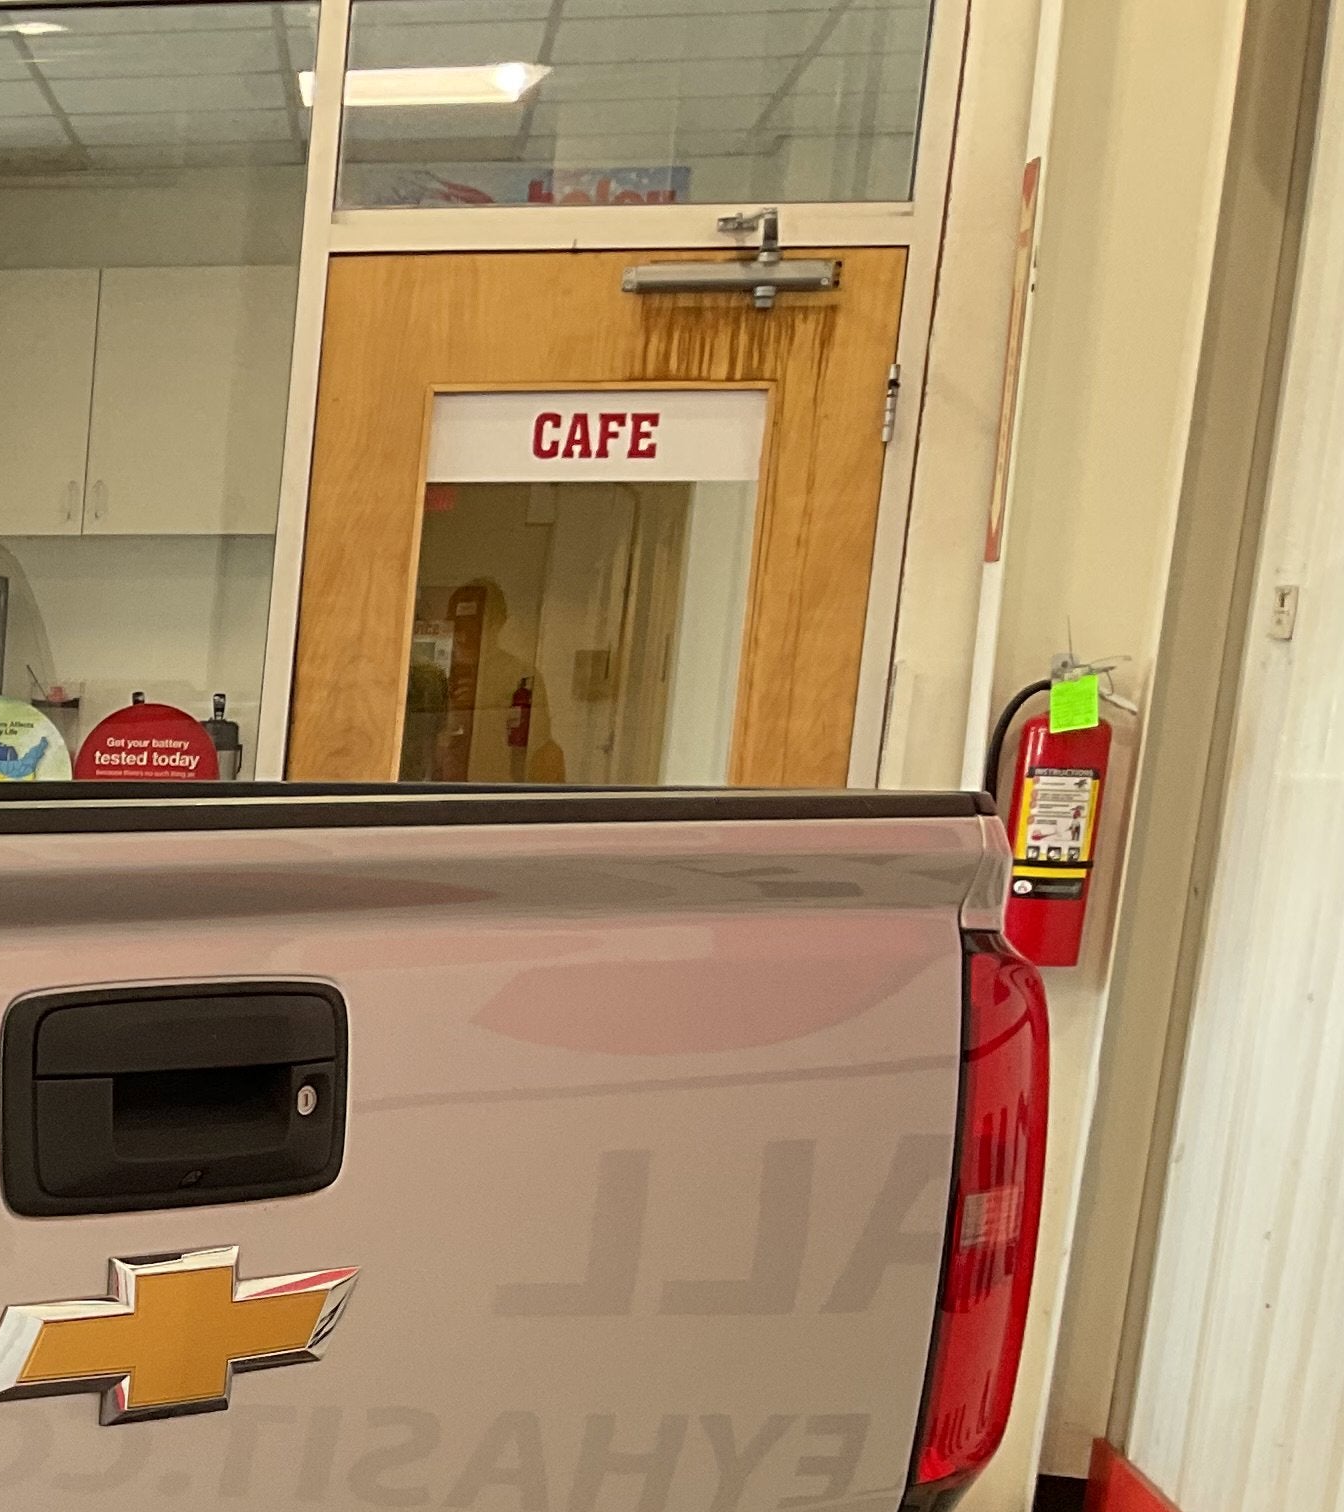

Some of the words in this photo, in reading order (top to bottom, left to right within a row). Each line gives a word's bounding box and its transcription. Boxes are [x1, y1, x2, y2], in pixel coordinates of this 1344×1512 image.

[532, 412, 660, 459] CAFE
[106, 737, 125, 748] Get
[127, 739, 150, 750] your
[151, 737, 190, 751] battery
[94, 750, 148, 766] tested
[152, 750, 200, 769] today
